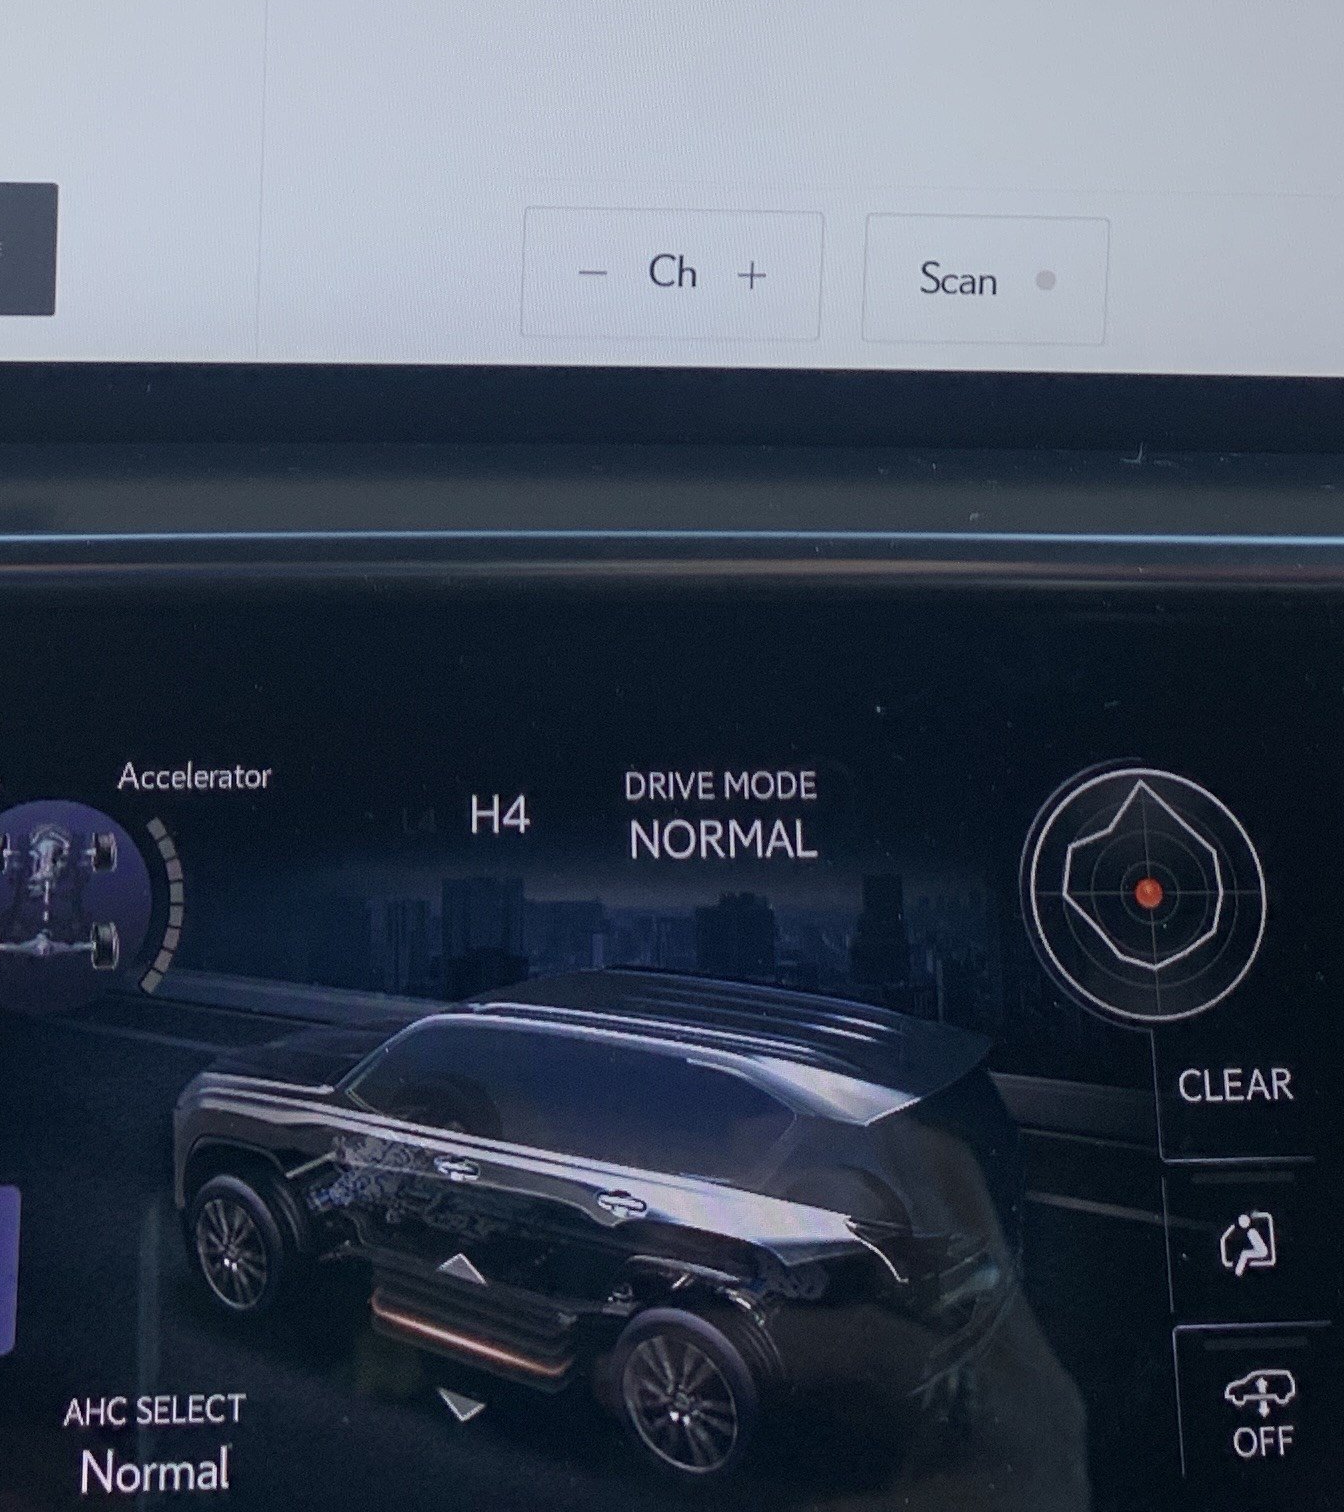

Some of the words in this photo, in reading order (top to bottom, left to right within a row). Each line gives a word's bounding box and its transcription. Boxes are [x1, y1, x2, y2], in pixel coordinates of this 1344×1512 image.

[649, 254, 696, 287] Ch
[921, 261, 997, 295] Scan
[117, 761, 271, 789] Accelerator
[626, 772, 714, 800] DRIVE
[725, 771, 817, 799] MODE
[472, 794, 530, 833] H4
[631, 819, 818, 859] NORMAL
[1179, 1068, 1293, 1102] CLEAR
[63, 1396, 126, 1426] AHC
[137, 1394, 246, 1424] SELECT
[1233, 1425, 1293, 1457] OFF
[82, 1446, 229, 1493] Normal
